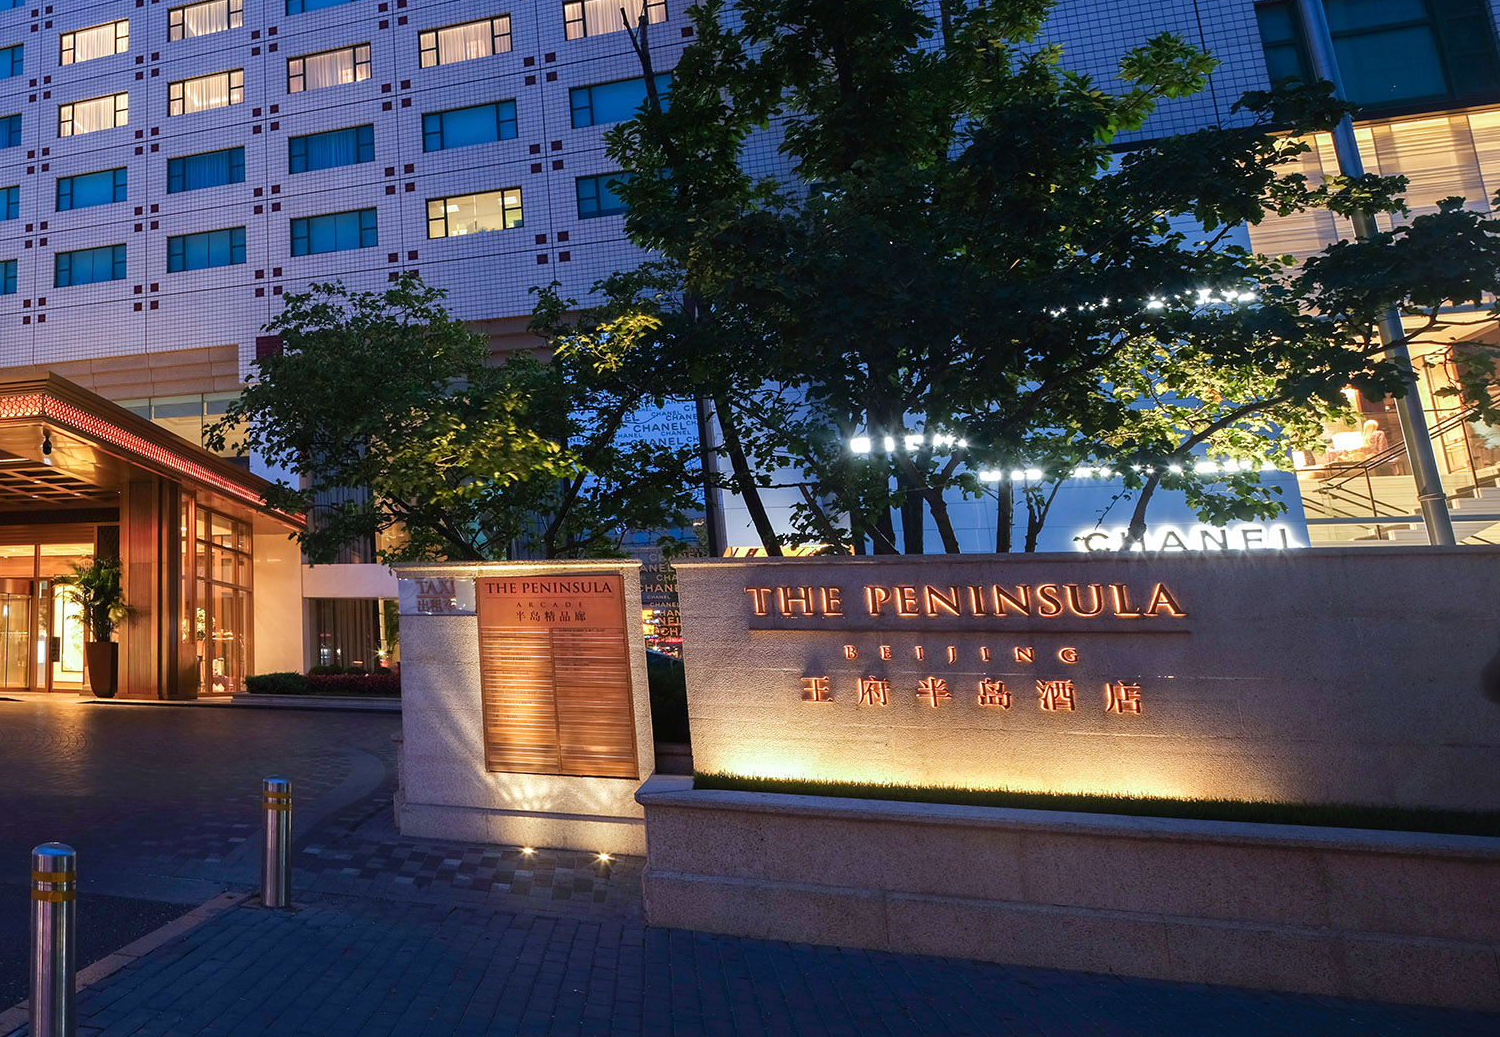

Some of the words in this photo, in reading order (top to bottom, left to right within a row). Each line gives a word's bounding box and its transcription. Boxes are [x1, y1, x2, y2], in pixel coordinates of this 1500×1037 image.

[633, 423, 687, 433] CHANEL
[415, 580, 456, 595] TAXI
[485, 582, 517, 594] THE
[522, 581, 612, 594] PENINSULA
[744, 586, 843, 616] THE
[864, 582, 1187, 618] PENINSULA
[843, 644, 1079, 664] BEIJING
[800, 675, 1143, 715] 王府半岛酒店
